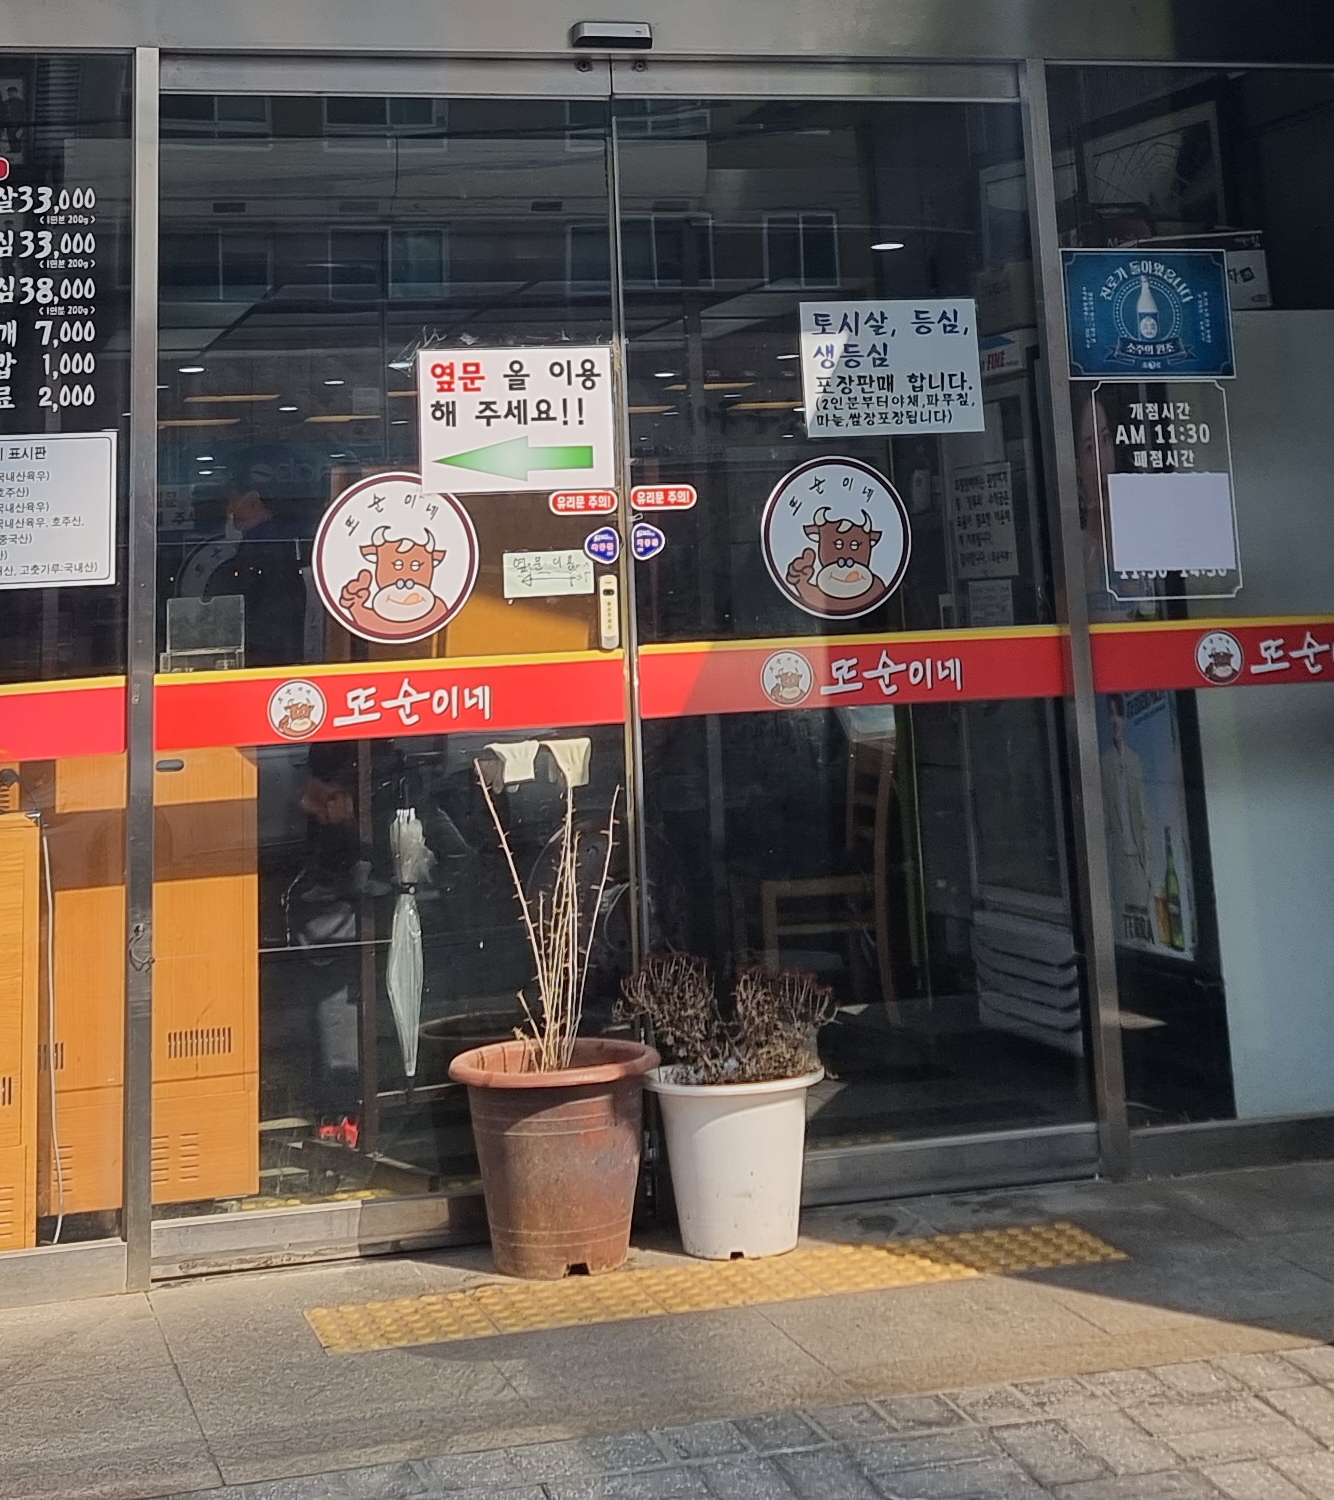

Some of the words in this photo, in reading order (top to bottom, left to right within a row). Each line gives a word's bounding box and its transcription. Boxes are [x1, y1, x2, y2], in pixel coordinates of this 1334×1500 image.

[16, 185, 96, 215] 33,000
[19, 230, 96, 259] 33,000
[19, 276, 96, 305] 38,000
[34, 320, 96, 348] 7,000
[811, 310, 897, 338] 토시살,
[910, 308, 969, 337] 등심,
[42, 351, 96, 381] 1,000
[813, 341, 890, 370] 생등심
[430, 361, 486, 393] 옆문
[503, 360, 530, 391] 을
[549, 358, 602, 391] 이용
[815, 373, 895, 395] 포장판매
[906, 371, 973, 393] 합니다.
[38, 384, 96, 413] 2,000
[430, 400, 457, 428] 해
[475, 398, 585, 428] 주세요!!
[1129, 402, 1191, 421] 개점시간
[1115, 424, 1147, 446] AM
[1154, 423, 1211, 445] 11:30
[8, 446, 47, 461] 표시판
[1133, 449, 1195, 469] 폐점시간
[557, 495, 586, 510] 유리문
[587, 494, 612, 509] 주의!
[636, 492, 665, 506] 유리문
[667, 490, 690, 505] 주의!
[820, 649, 964, 695] 또순이네
[333, 677, 492, 728] 또순이네
